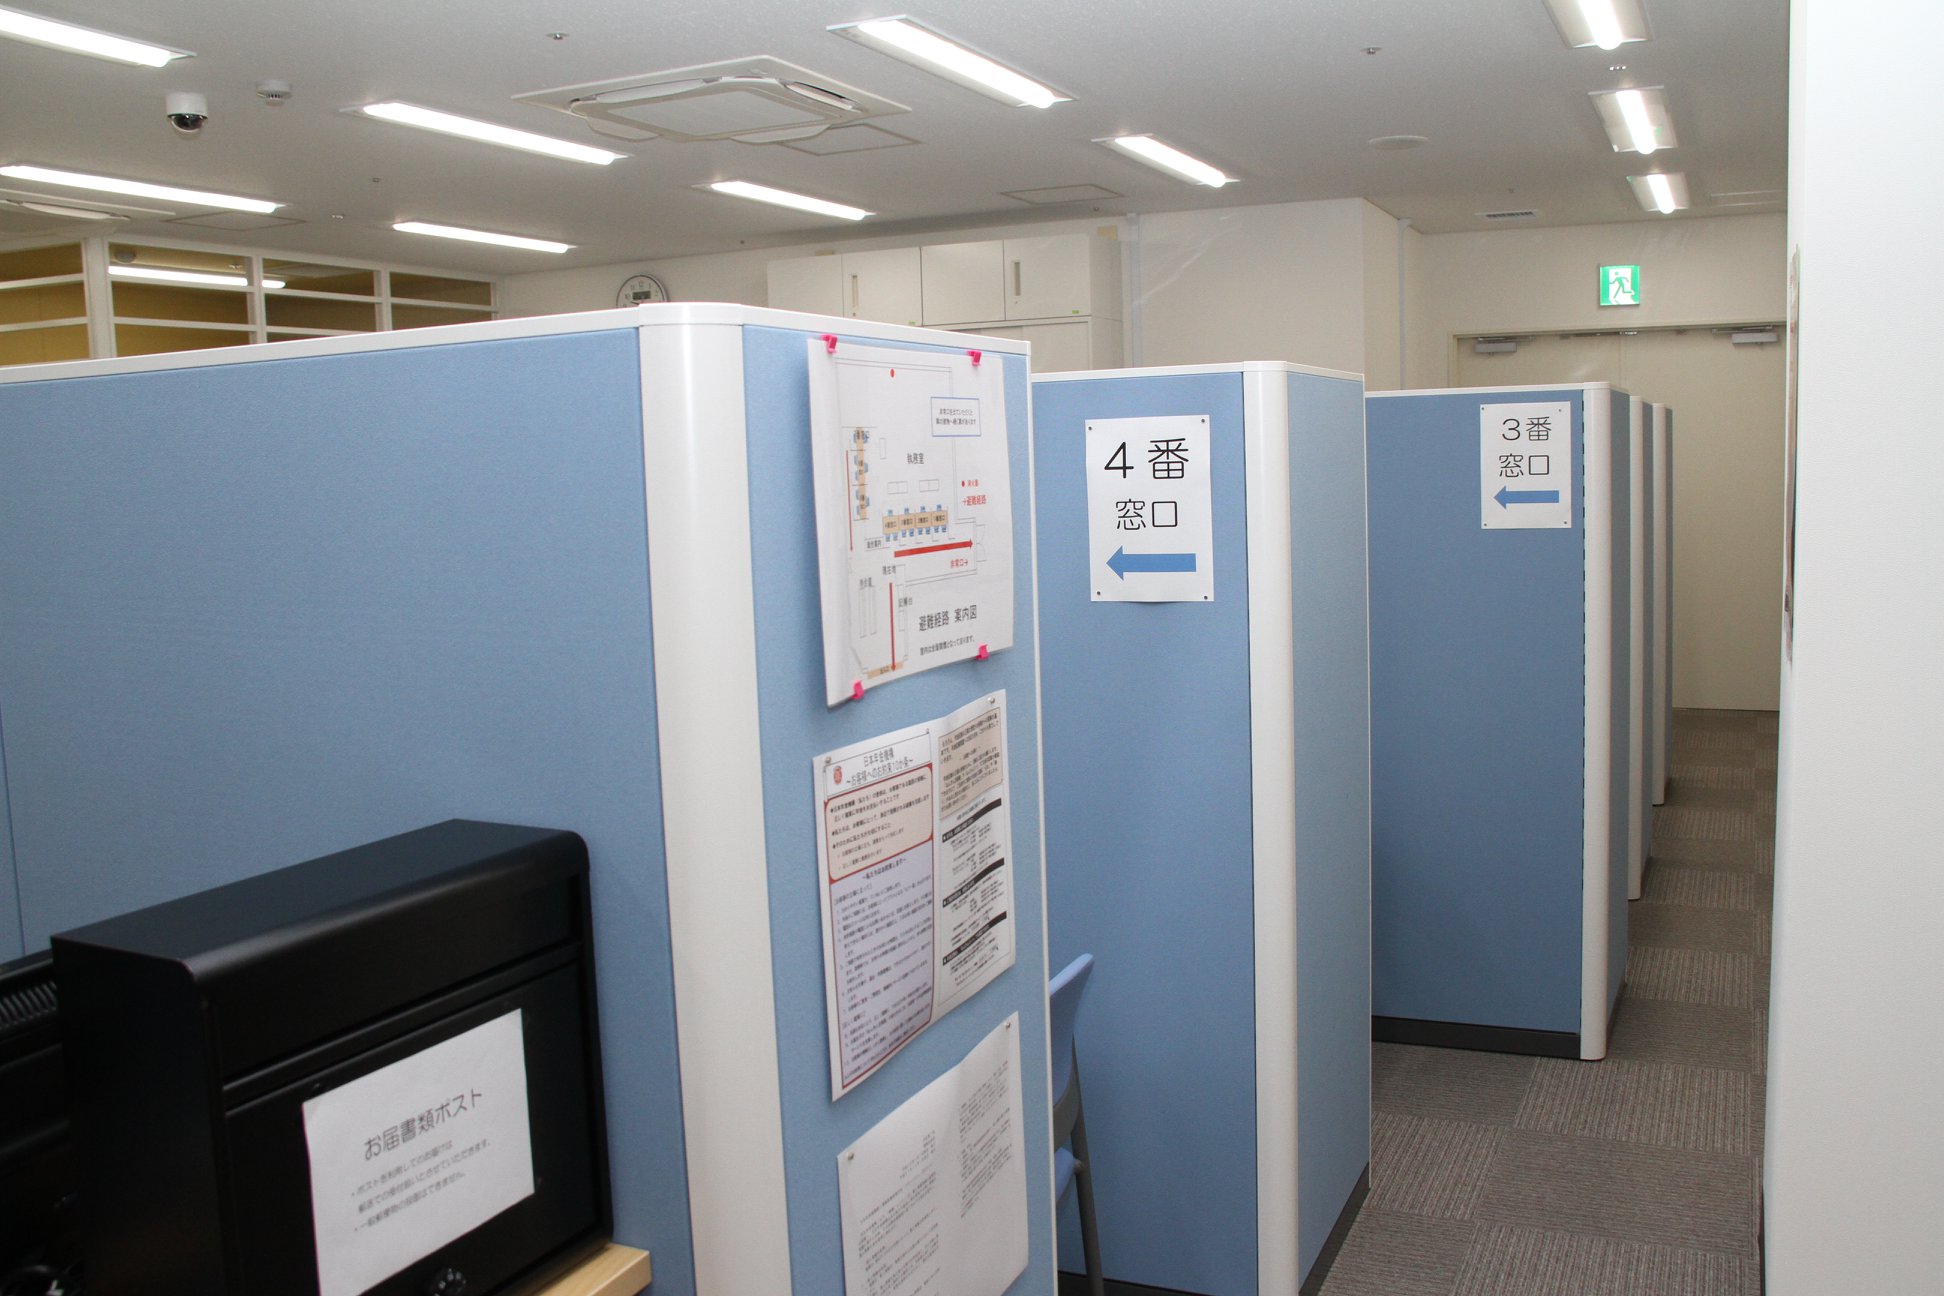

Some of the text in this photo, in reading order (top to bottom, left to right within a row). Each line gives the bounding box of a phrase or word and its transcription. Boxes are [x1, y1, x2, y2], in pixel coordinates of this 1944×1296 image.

[1502, 416, 1552, 441] 3番
[907, 452, 925, 464] 執務室
[1103, 438, 1189, 479] 4番
[1499, 453, 1550, 478] 窓口
[1115, 498, 1178, 531] 窓口
[919, 604, 977, 631] 避難経路 案内図
[863, 747, 894, 767] 日本年金機構
[364, 1088, 482, 1161] お届書類ポスト
